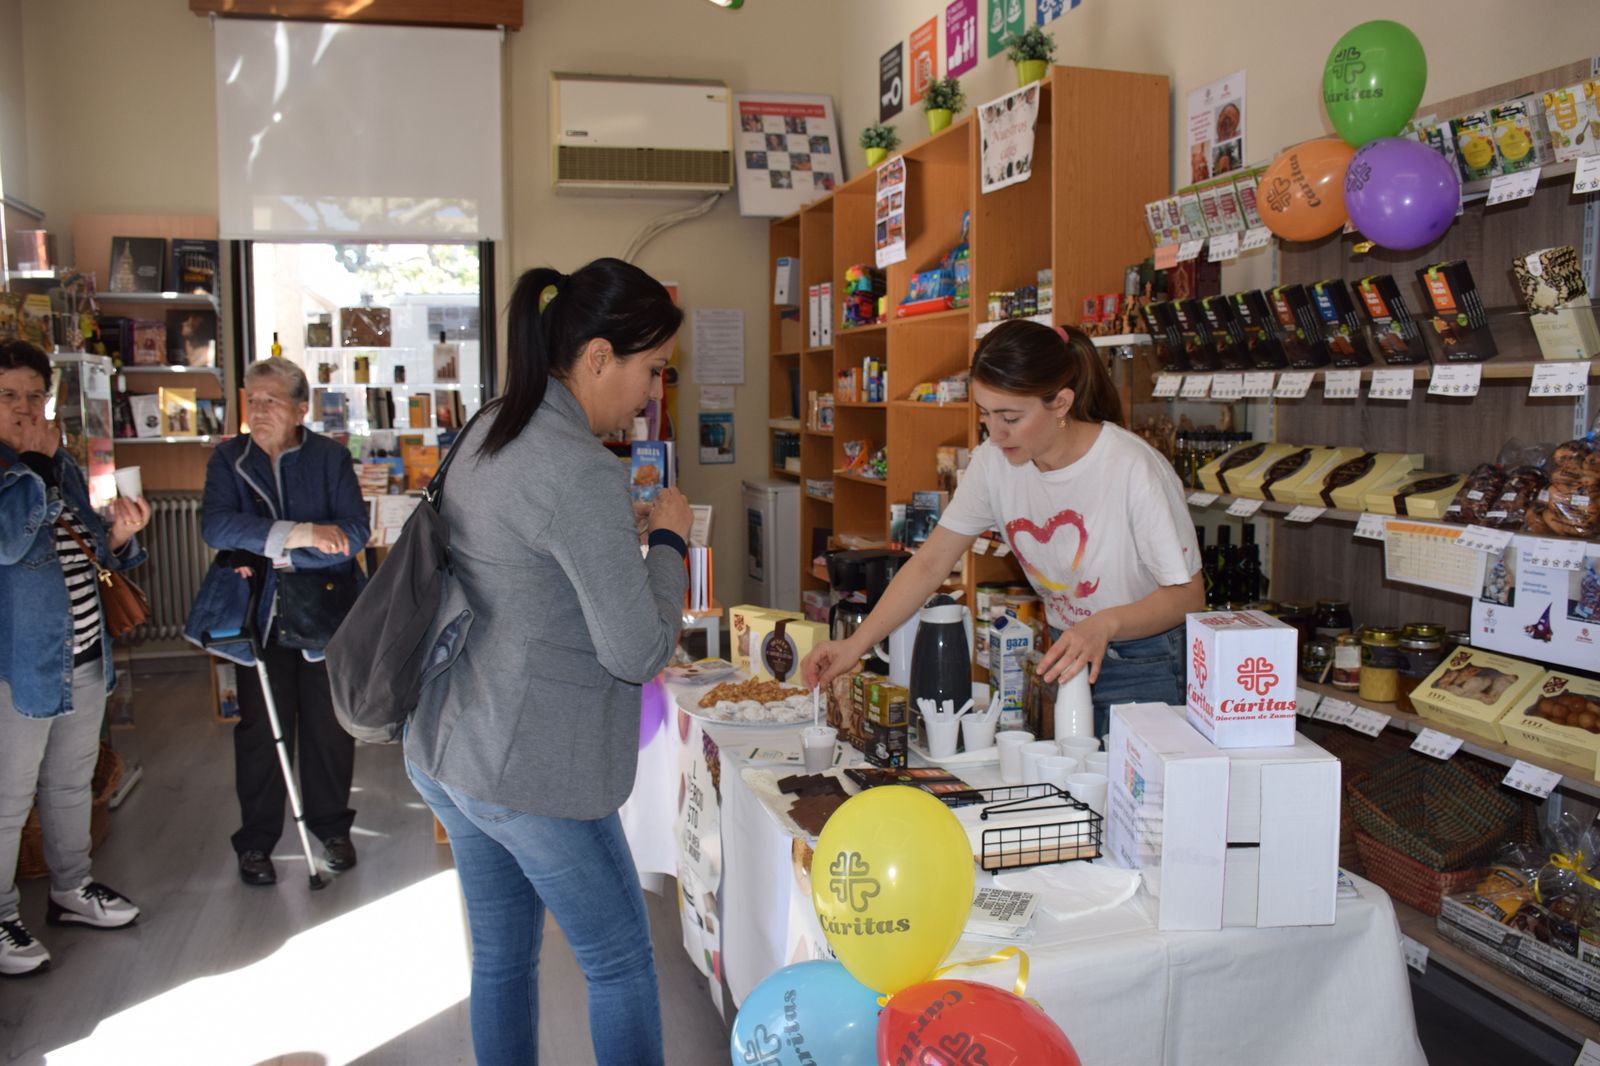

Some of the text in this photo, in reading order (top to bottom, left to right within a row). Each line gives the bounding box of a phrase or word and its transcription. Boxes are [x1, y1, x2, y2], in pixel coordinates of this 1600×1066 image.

[1006, 637, 1029, 650] gaza
[1220, 698, 1296, 714] Cáritas
[819, 914, 911, 935] Cáritas
